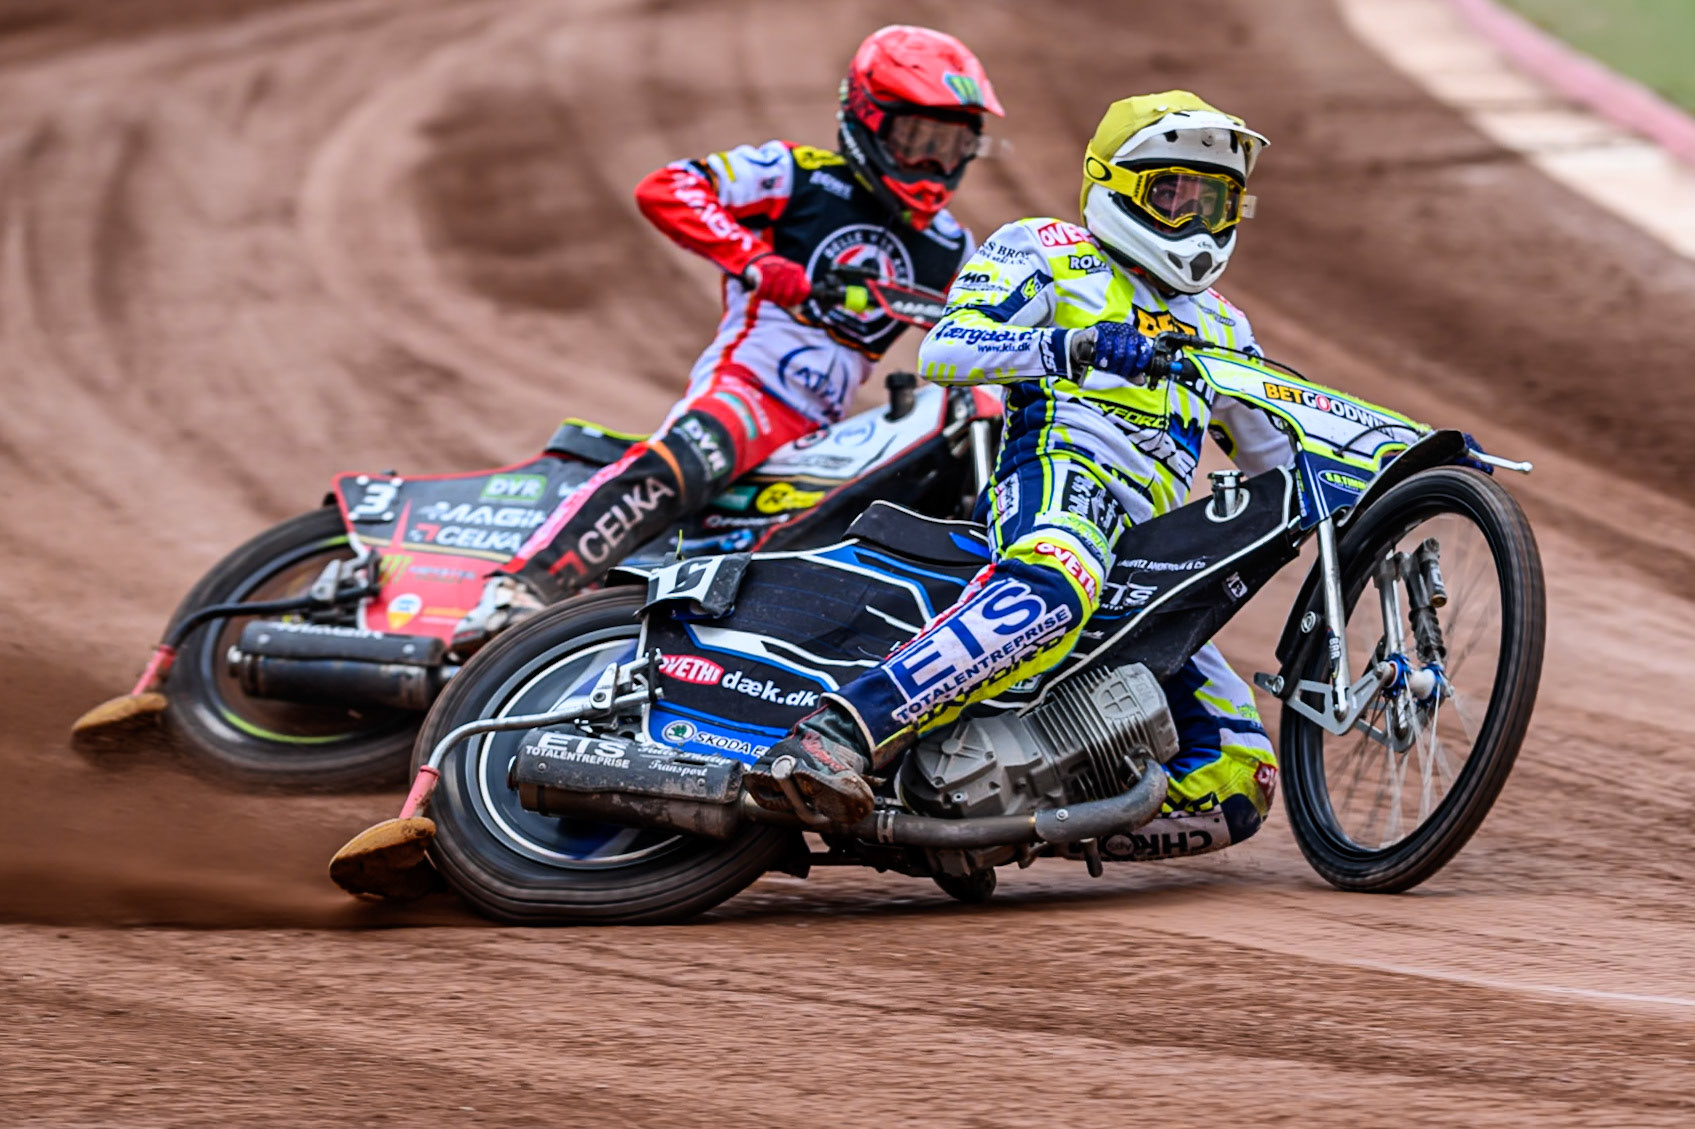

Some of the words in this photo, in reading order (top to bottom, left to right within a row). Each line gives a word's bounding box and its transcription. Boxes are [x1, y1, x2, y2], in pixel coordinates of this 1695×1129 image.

[355, 483, 397, 516] 3
[487, 478, 542, 498] DVR
[578, 476, 675, 565] CELKA
[435, 526, 522, 551] CELKA
[888, 580, 1042, 700] ETS
[896, 608, 1068, 722] TOTALENTREPRISE
[721, 671, 819, 707] dæk.dk
[525, 745, 630, 769] TOTALENTREPRISE
[537, 732, 628, 758] ETS
[648, 759, 708, 777] Transport
